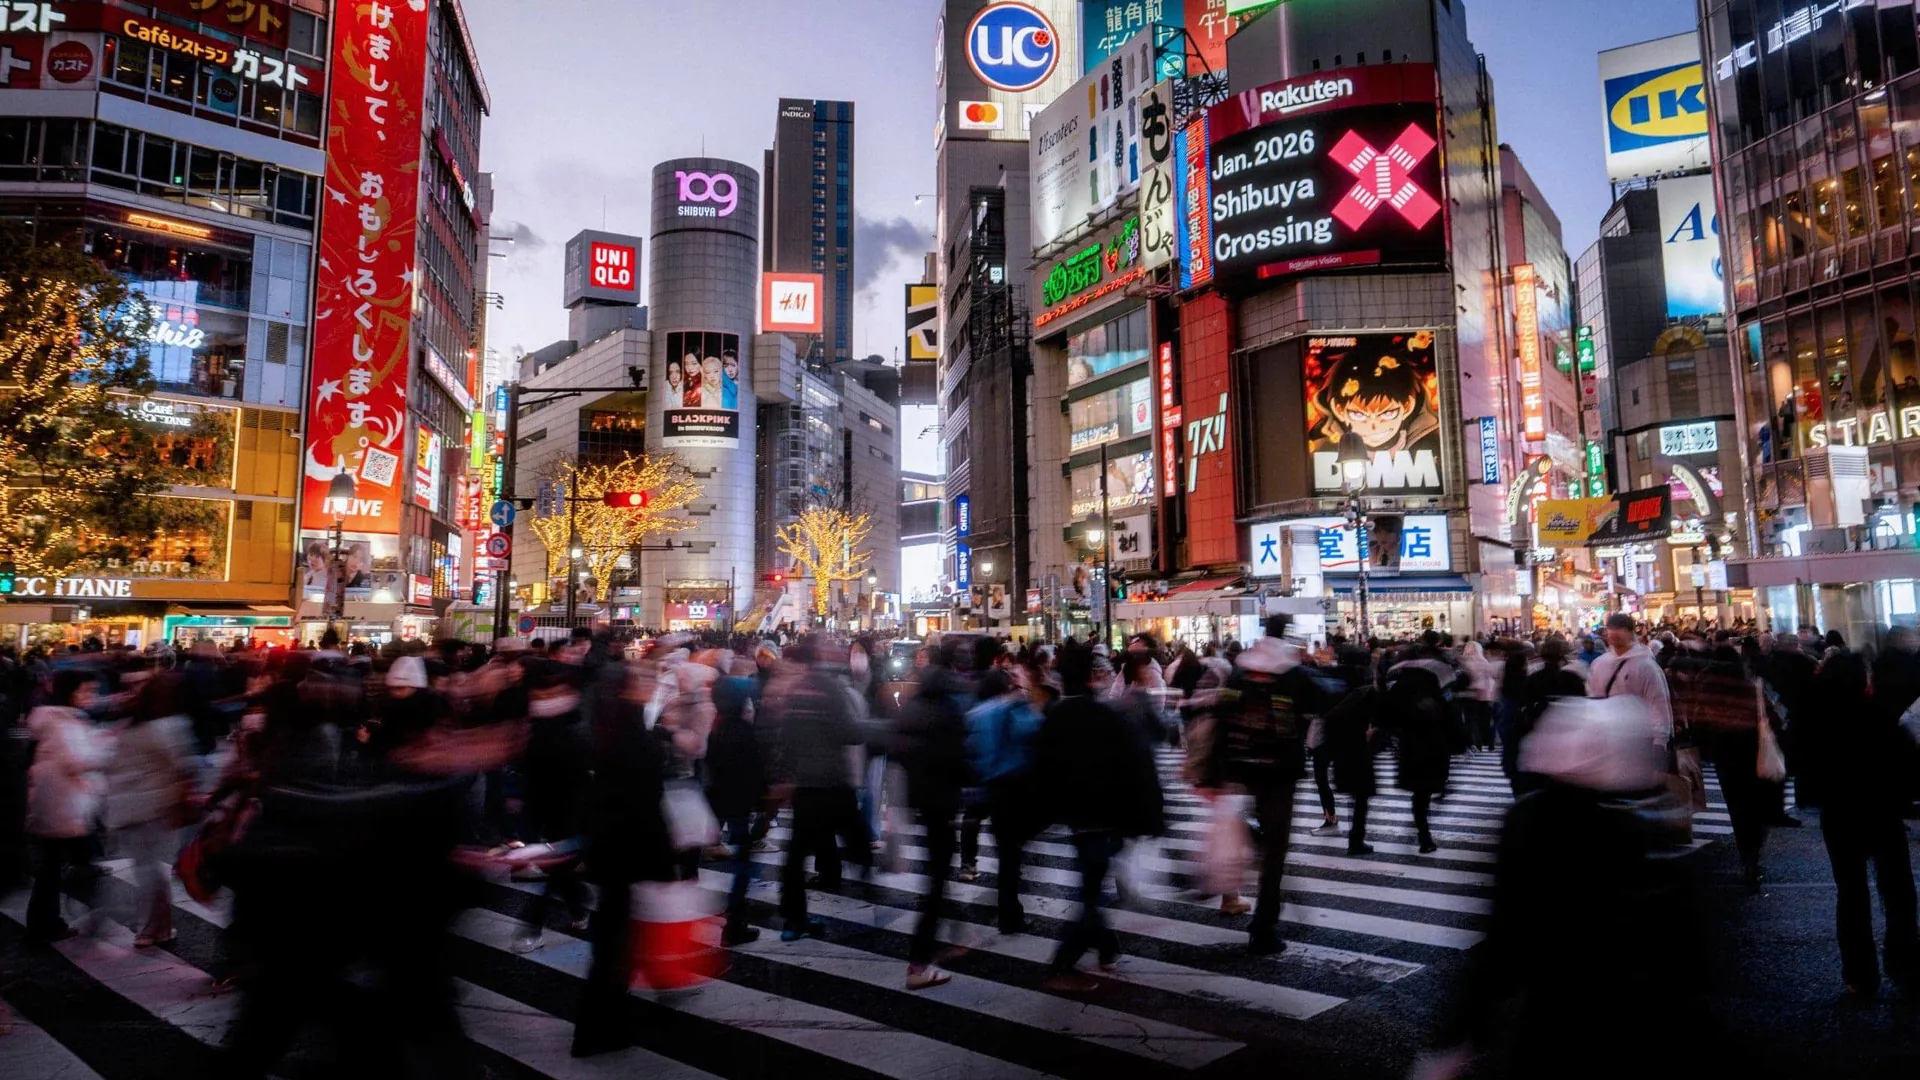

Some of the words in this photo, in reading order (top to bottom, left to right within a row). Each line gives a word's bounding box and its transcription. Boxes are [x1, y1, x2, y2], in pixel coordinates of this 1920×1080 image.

[231, 48, 309, 91] ガスト
[1260, 78, 1353, 114] Rakuten
[1038, 115, 1079, 156] Viscotecs
[1212, 153, 1252, 181] Jan.
[1254, 129, 1315, 167] 2026
[675, 171, 738, 217] 109
[1142, 91, 1174, 256] もんじゃ
[678, 206, 716, 217] SHIBUYA
[1213, 178, 1315, 222] Shibuya
[595, 247, 628, 267] UNI
[1215, 214, 1333, 261] Crossing
[594, 266, 630, 285] QLO
[1288, 259, 1318, 271] Rakuten
[1319, 255, 1342, 265] Vision
[1187, 391, 1228, 492] クスリ
[960, 502, 968, 531] MIZUHO
